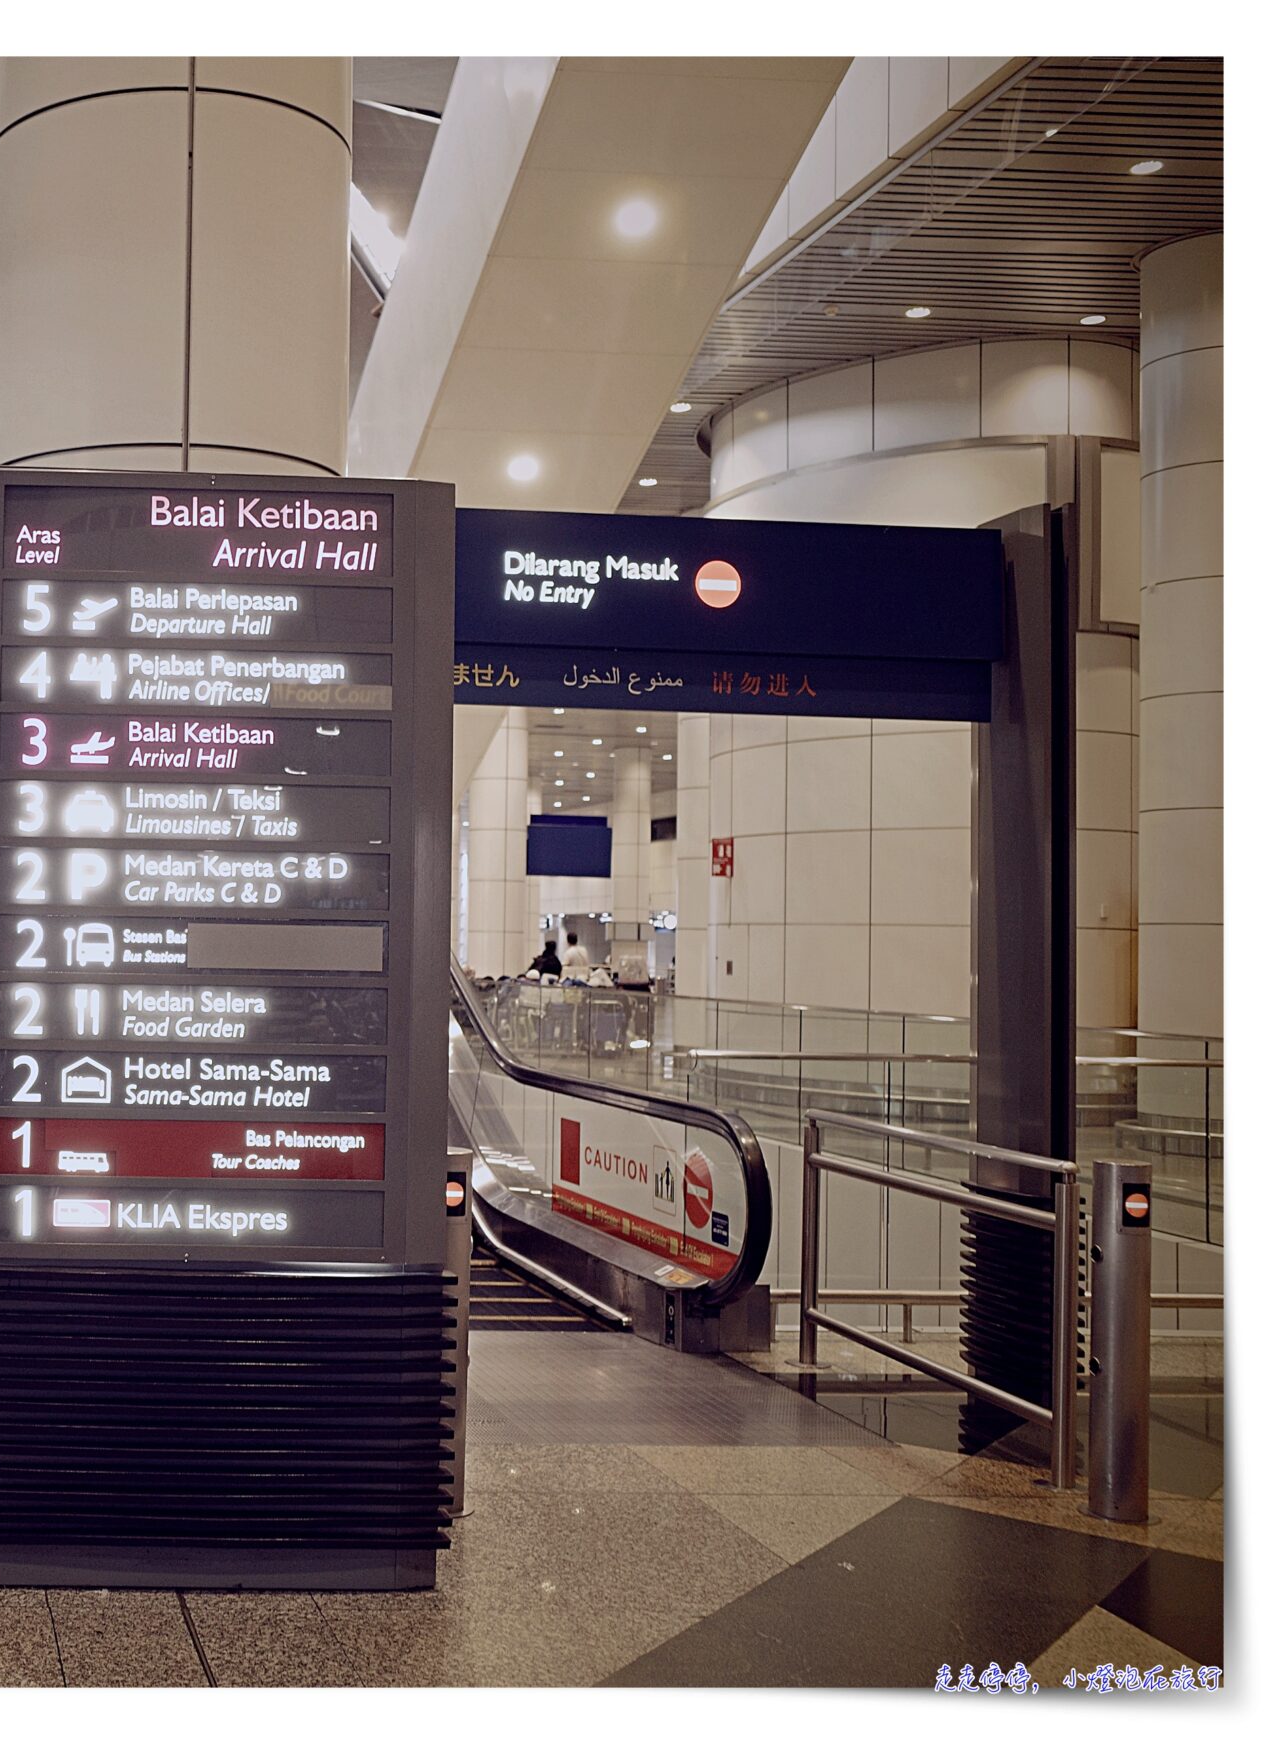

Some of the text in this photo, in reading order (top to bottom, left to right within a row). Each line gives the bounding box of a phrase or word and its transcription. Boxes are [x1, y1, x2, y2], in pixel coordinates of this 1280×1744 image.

[150, 495, 379, 532] Balai Ketibaan
[16, 525, 61, 545] Aras
[16, 546, 61, 565] Level
[213, 538, 378, 572] Arrival Hall
[504, 550, 680, 584] Dilarang Masuk
[22, 584, 51, 632] 5
[130, 587, 298, 615] Balai Perlepasan
[504, 579, 595, 610] No Entry
[130, 614, 272, 637] Departure Hall
[20, 651, 51, 698] 4
[128, 654, 345, 685] Pejabat Penerbangan
[563, 665, 684, 695] ممنوع الدخول
[129, 681, 271, 706] Airline Offices/
[22, 718, 48, 765] 3
[128, 721, 274, 745] Balai Ketibaan
[129, 747, 238, 769] Arrival Hall
[18, 784, 45, 832] 3
[125, 788, 206, 810] Limosin
[227, 788, 281, 811] Teksi
[125, 814, 231, 834] Limousines
[251, 817, 298, 837] Taxis
[16, 853, 46, 900] 2
[125, 856, 348, 879] Medan Kereta C & D
[124, 882, 282, 904] Car Parks C & D
[16, 920, 46, 967] 2
[166, 929, 187, 944] Bas
[122, 949, 142, 963] Bus
[14, 987, 43, 1035] 2
[122, 991, 267, 1014] Medan Selera
[122, 1018, 245, 1039] Food Garden
[12, 1055, 42, 1102] 2
[124, 1058, 331, 1082] Hotel Sama-Sama
[125, 1086, 310, 1108] Sama-Sama Hotel
[12, 1121, 32, 1167] 1
[246, 1131, 365, 1152] Bas Pelancongan
[211, 1154, 300, 1171] Tour Coaches
[584, 1145, 649, 1184] CAUTION
[14, 1190, 33, 1236] 1
[117, 1203, 288, 1235] KLIA Ekspres
